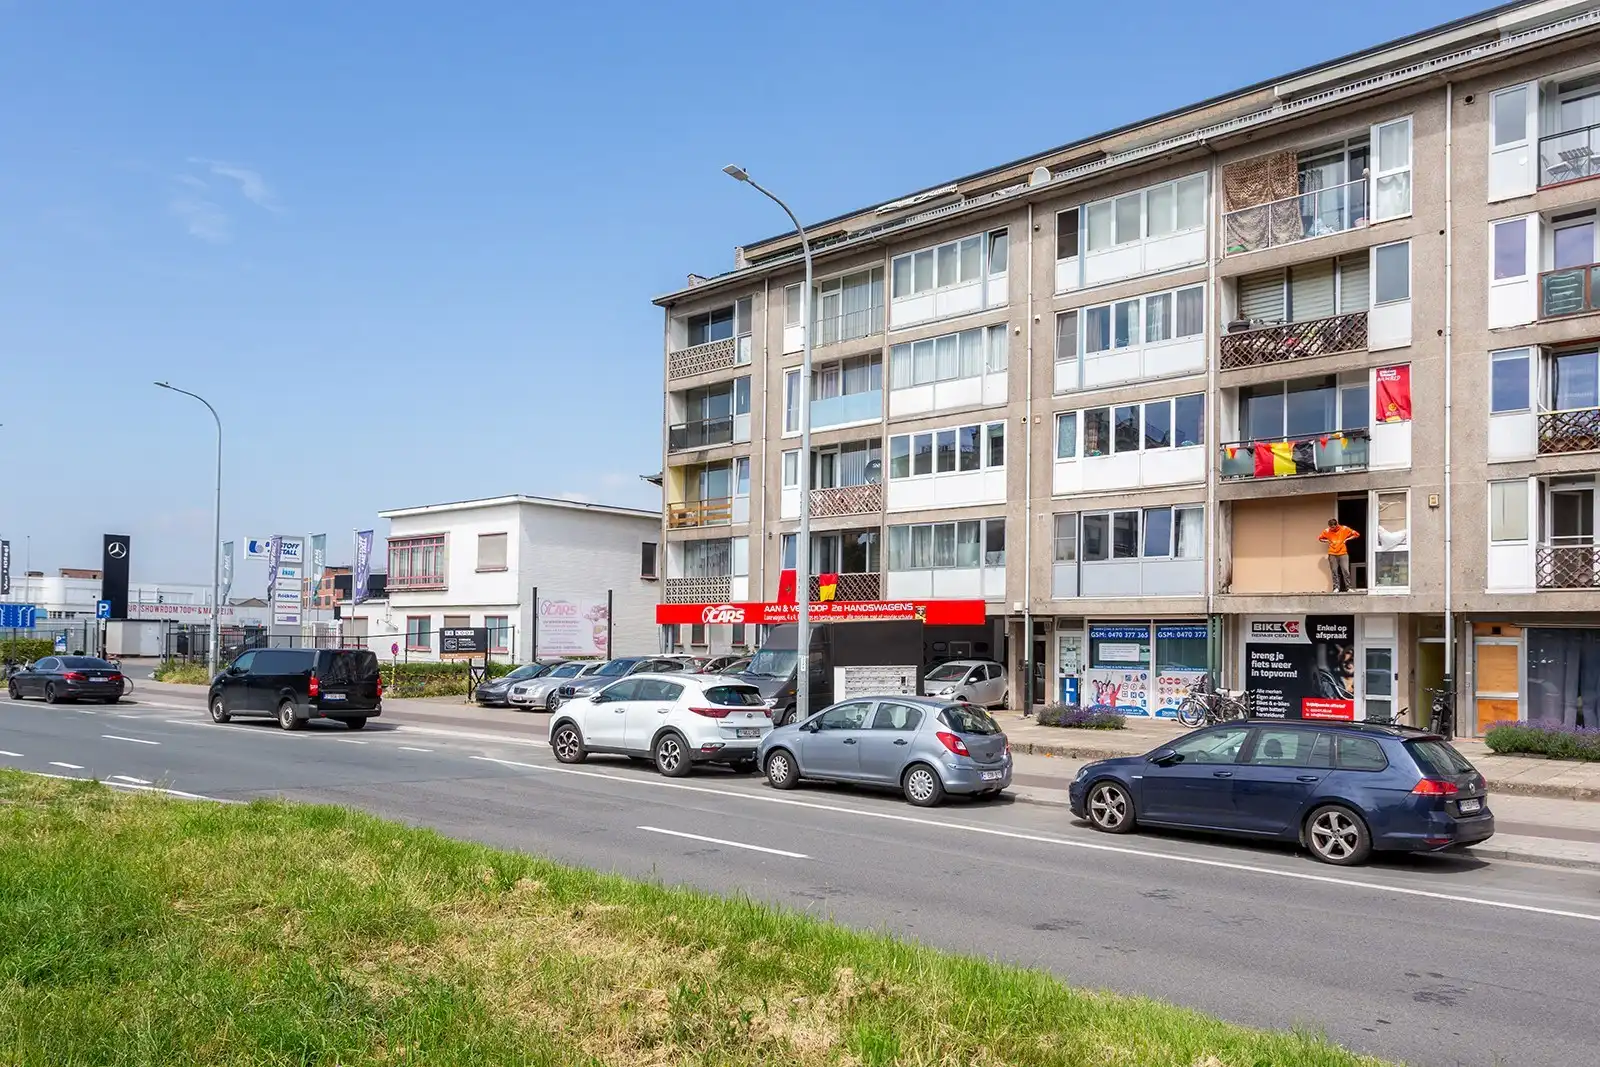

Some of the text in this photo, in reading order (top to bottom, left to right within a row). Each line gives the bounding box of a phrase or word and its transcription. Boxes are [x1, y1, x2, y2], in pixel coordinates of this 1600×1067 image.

[98, 604, 109, 615] P
[140, 605, 178, 614] SHOWROOM
[764, 602, 914, 613] AAN & VEKOOP 2e HANDSWAGENS
[1253, 623, 1282, 631] BIKE
[1251, 652, 1284, 661] breng je
[1251, 660, 1269, 668] fiets
[1065, 679, 1075, 692] L
